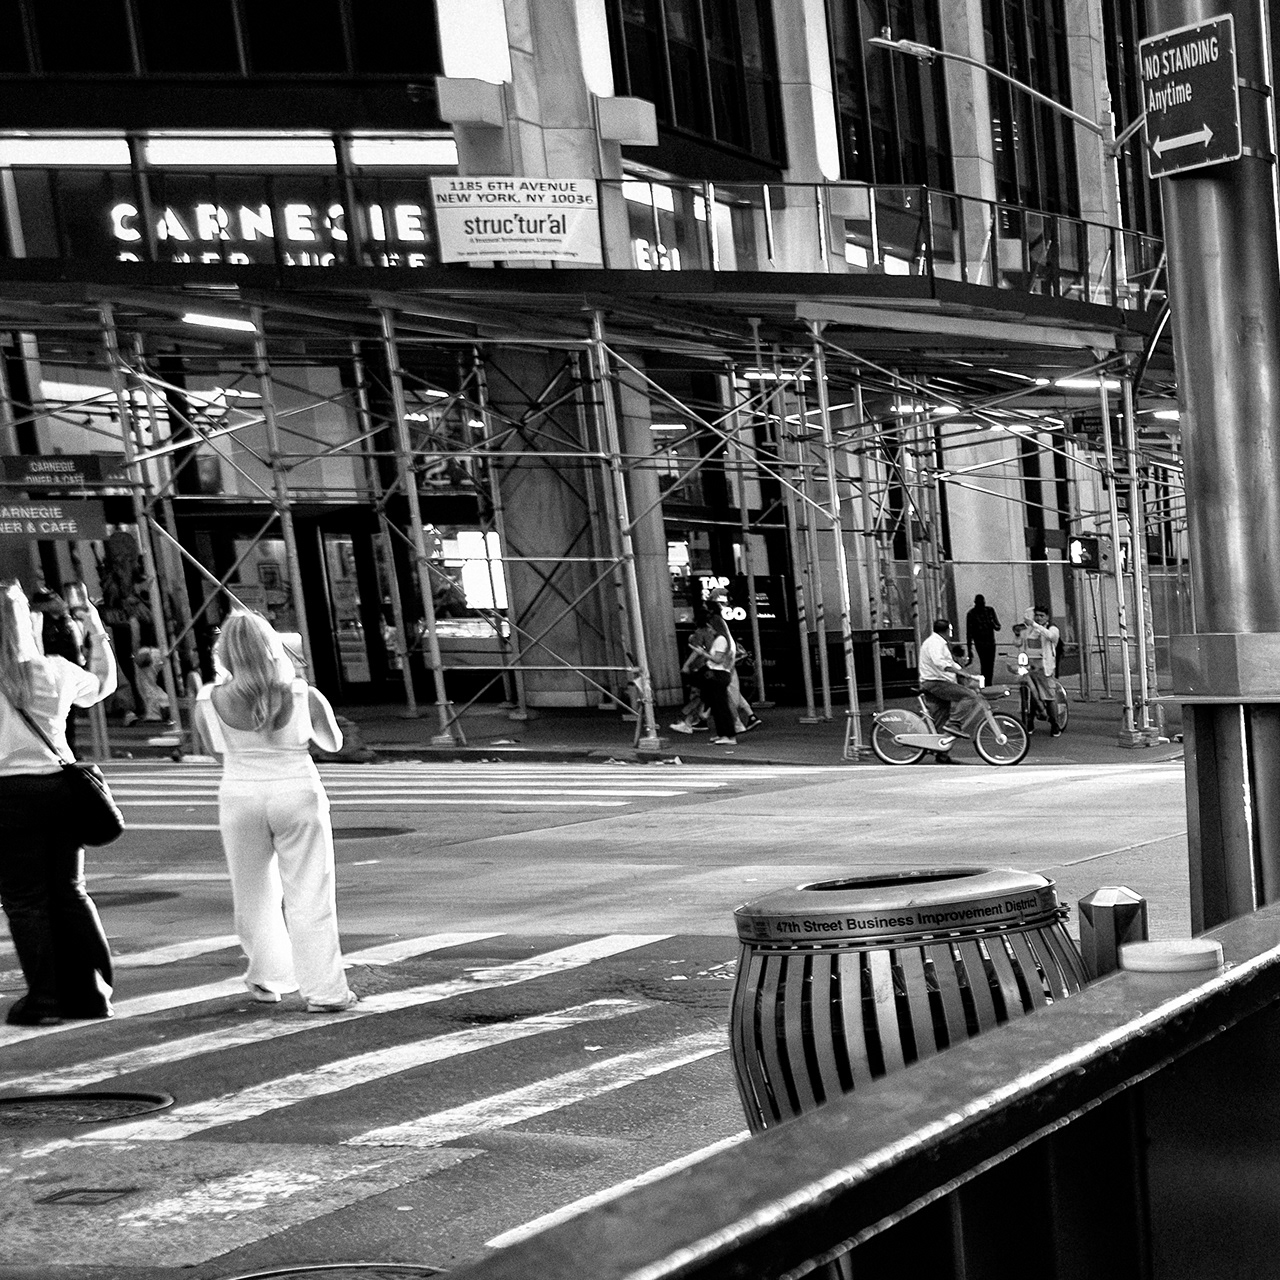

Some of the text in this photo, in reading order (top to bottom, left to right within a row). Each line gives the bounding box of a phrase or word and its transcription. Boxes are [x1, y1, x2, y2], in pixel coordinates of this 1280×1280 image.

[1145, 37, 1219, 81] NO STANDING
[1149, 81, 1193, 114] Anytime
[450, 181, 578, 192] 1185 6TH AVENUE
[437, 193, 472, 203] NEW
[526, 194, 546, 204] NY
[551, 194, 594, 205] 10036
[0, 507, 63, 519] ARNEGIE
[700, 577, 730, 589] TAP
[776, 921, 801, 933] 47th
[803, 919, 844, 932] Street
[847, 912, 914, 931] Business
[916, 904, 1004, 927] Improvement
[1005, 895, 1038, 912] District
